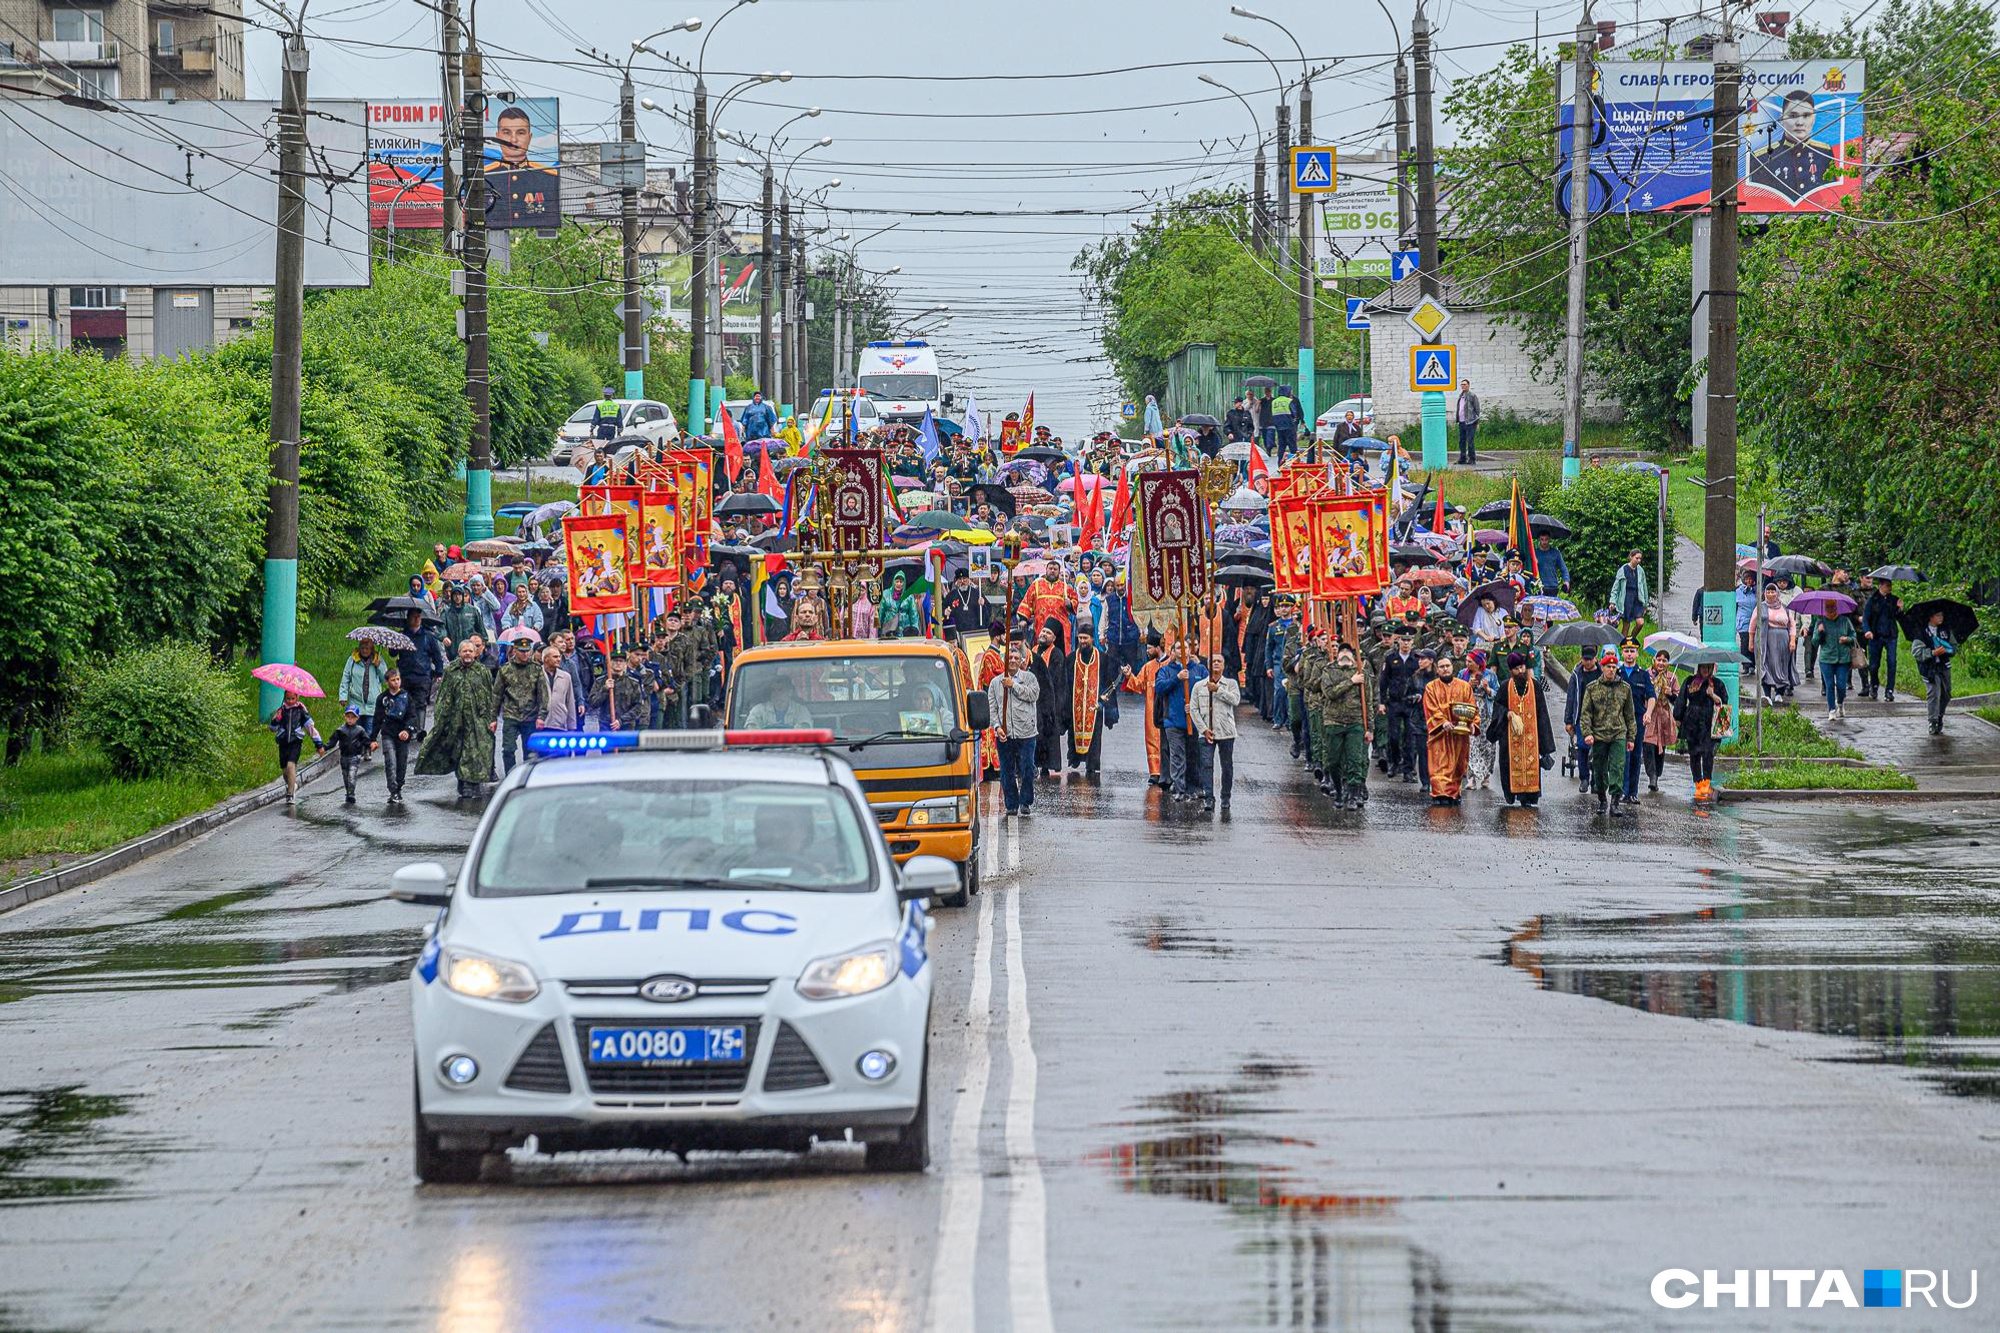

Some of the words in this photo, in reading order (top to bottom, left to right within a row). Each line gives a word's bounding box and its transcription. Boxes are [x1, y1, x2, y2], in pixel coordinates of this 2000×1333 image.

[1620, 75, 1669, 86] СЛАВА
[1674, 75, 1714, 86] ГЕРОЯ
[1740, 73, 1805, 85] РОССИИ!
[1612, 110, 1685, 124] ЦЫДЫПОВ
[1609, 125, 1642, 133] БАЛДАН
[368, 138, 421, 150] ЕМЯКИН
[1348, 212, 1362, 230] 8
[1363, 263, 1391, 274] 500-
[538, 908, 798, 939] ДПС
[651, 982, 683, 997] Ford
[708, 1028, 737, 1050] 75
